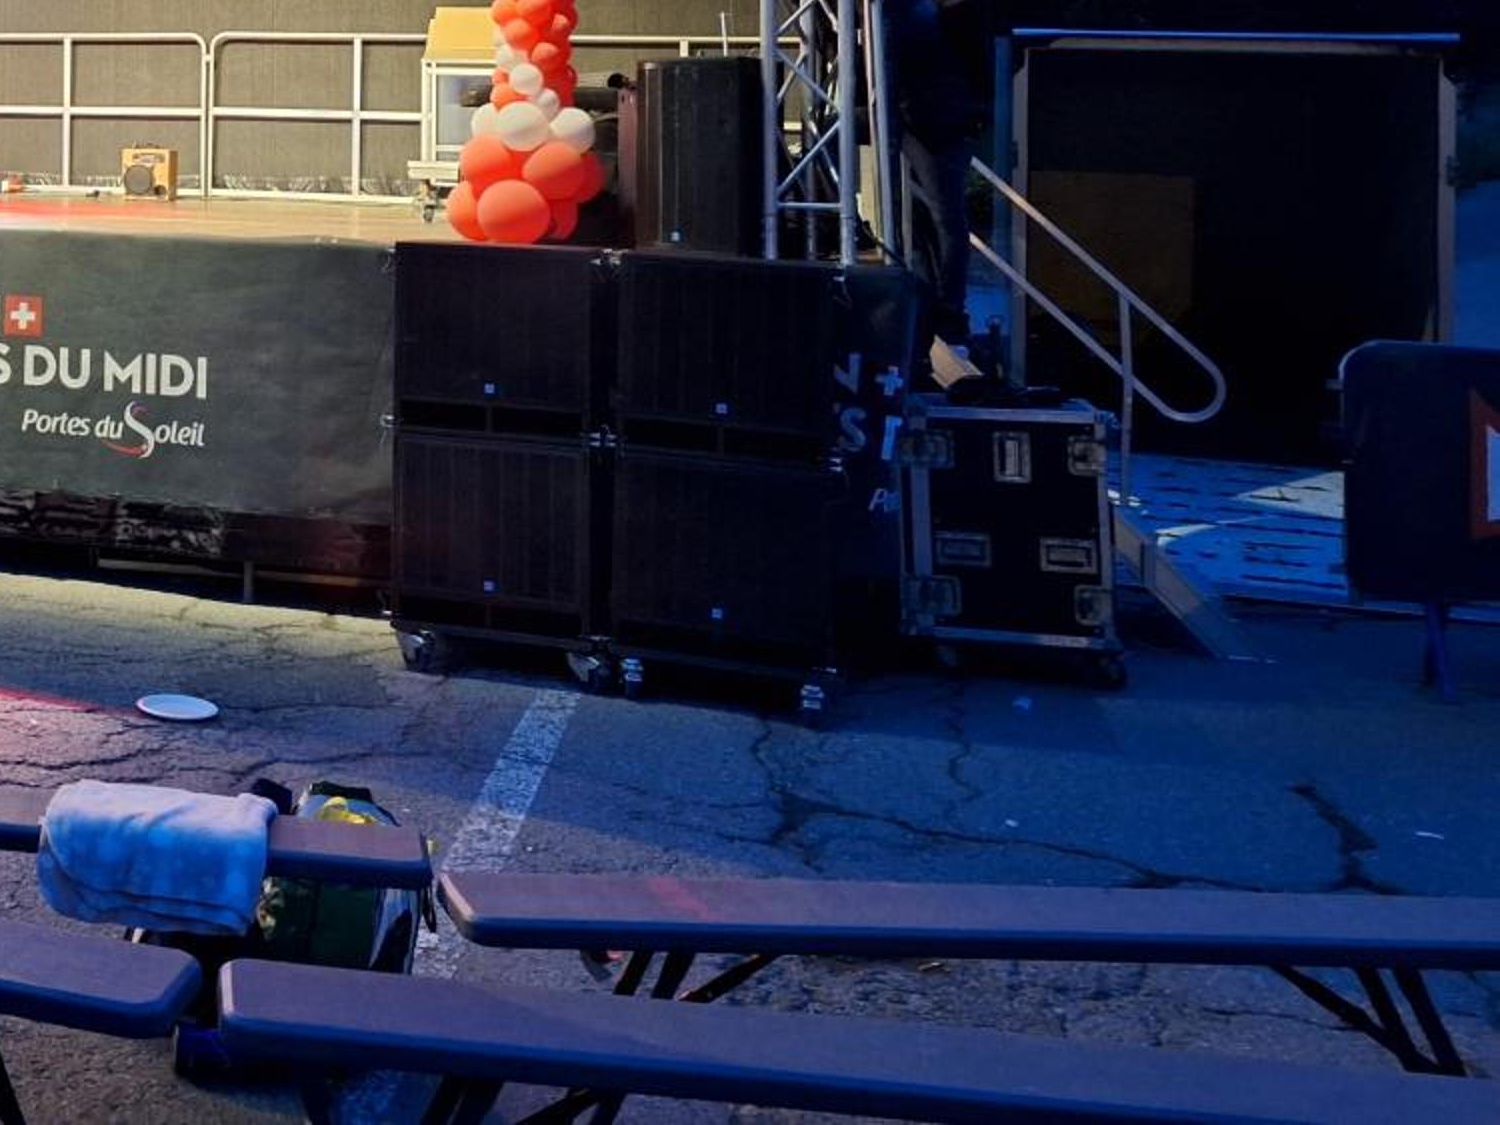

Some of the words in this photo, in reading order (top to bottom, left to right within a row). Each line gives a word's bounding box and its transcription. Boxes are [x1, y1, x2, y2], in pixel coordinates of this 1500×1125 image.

[23, 344, 91, 389] DU
[103, 350, 208, 400] MIDI
[21, 408, 91, 437] Portes
[94, 415, 124, 440] du
[123, 400, 205, 459] Soleil
